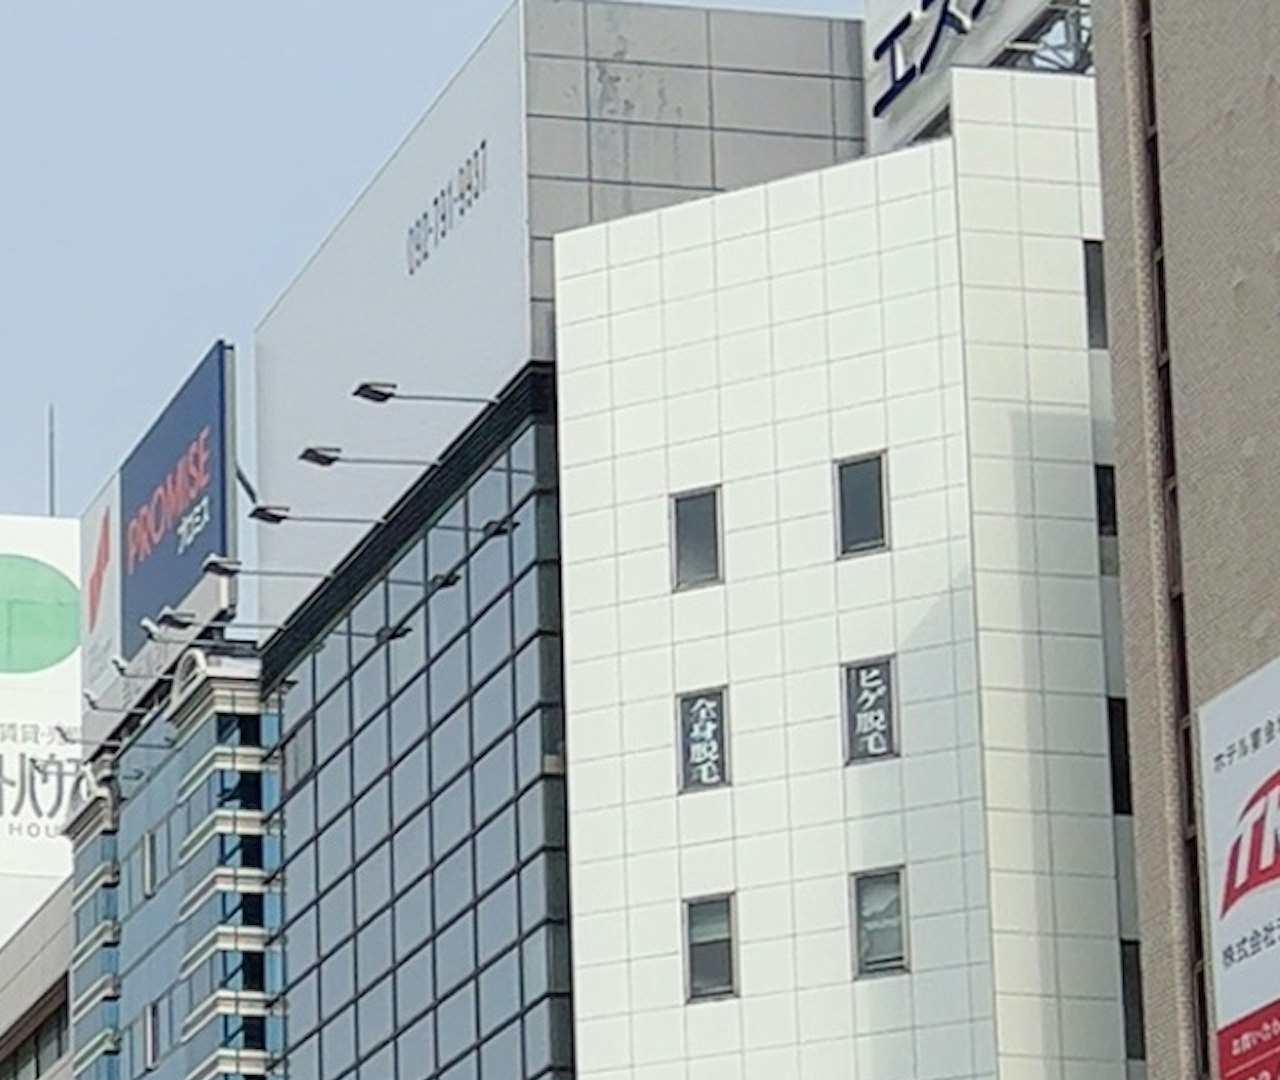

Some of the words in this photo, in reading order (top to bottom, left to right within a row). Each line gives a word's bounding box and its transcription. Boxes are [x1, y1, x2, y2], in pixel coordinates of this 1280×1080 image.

[873, 0, 987, 118] エス
[126, 424, 210, 576] PROMISE
[689, 698, 721, 785] 全身脱毛
[855, 667, 888, 754] ヒゲ脱毛
